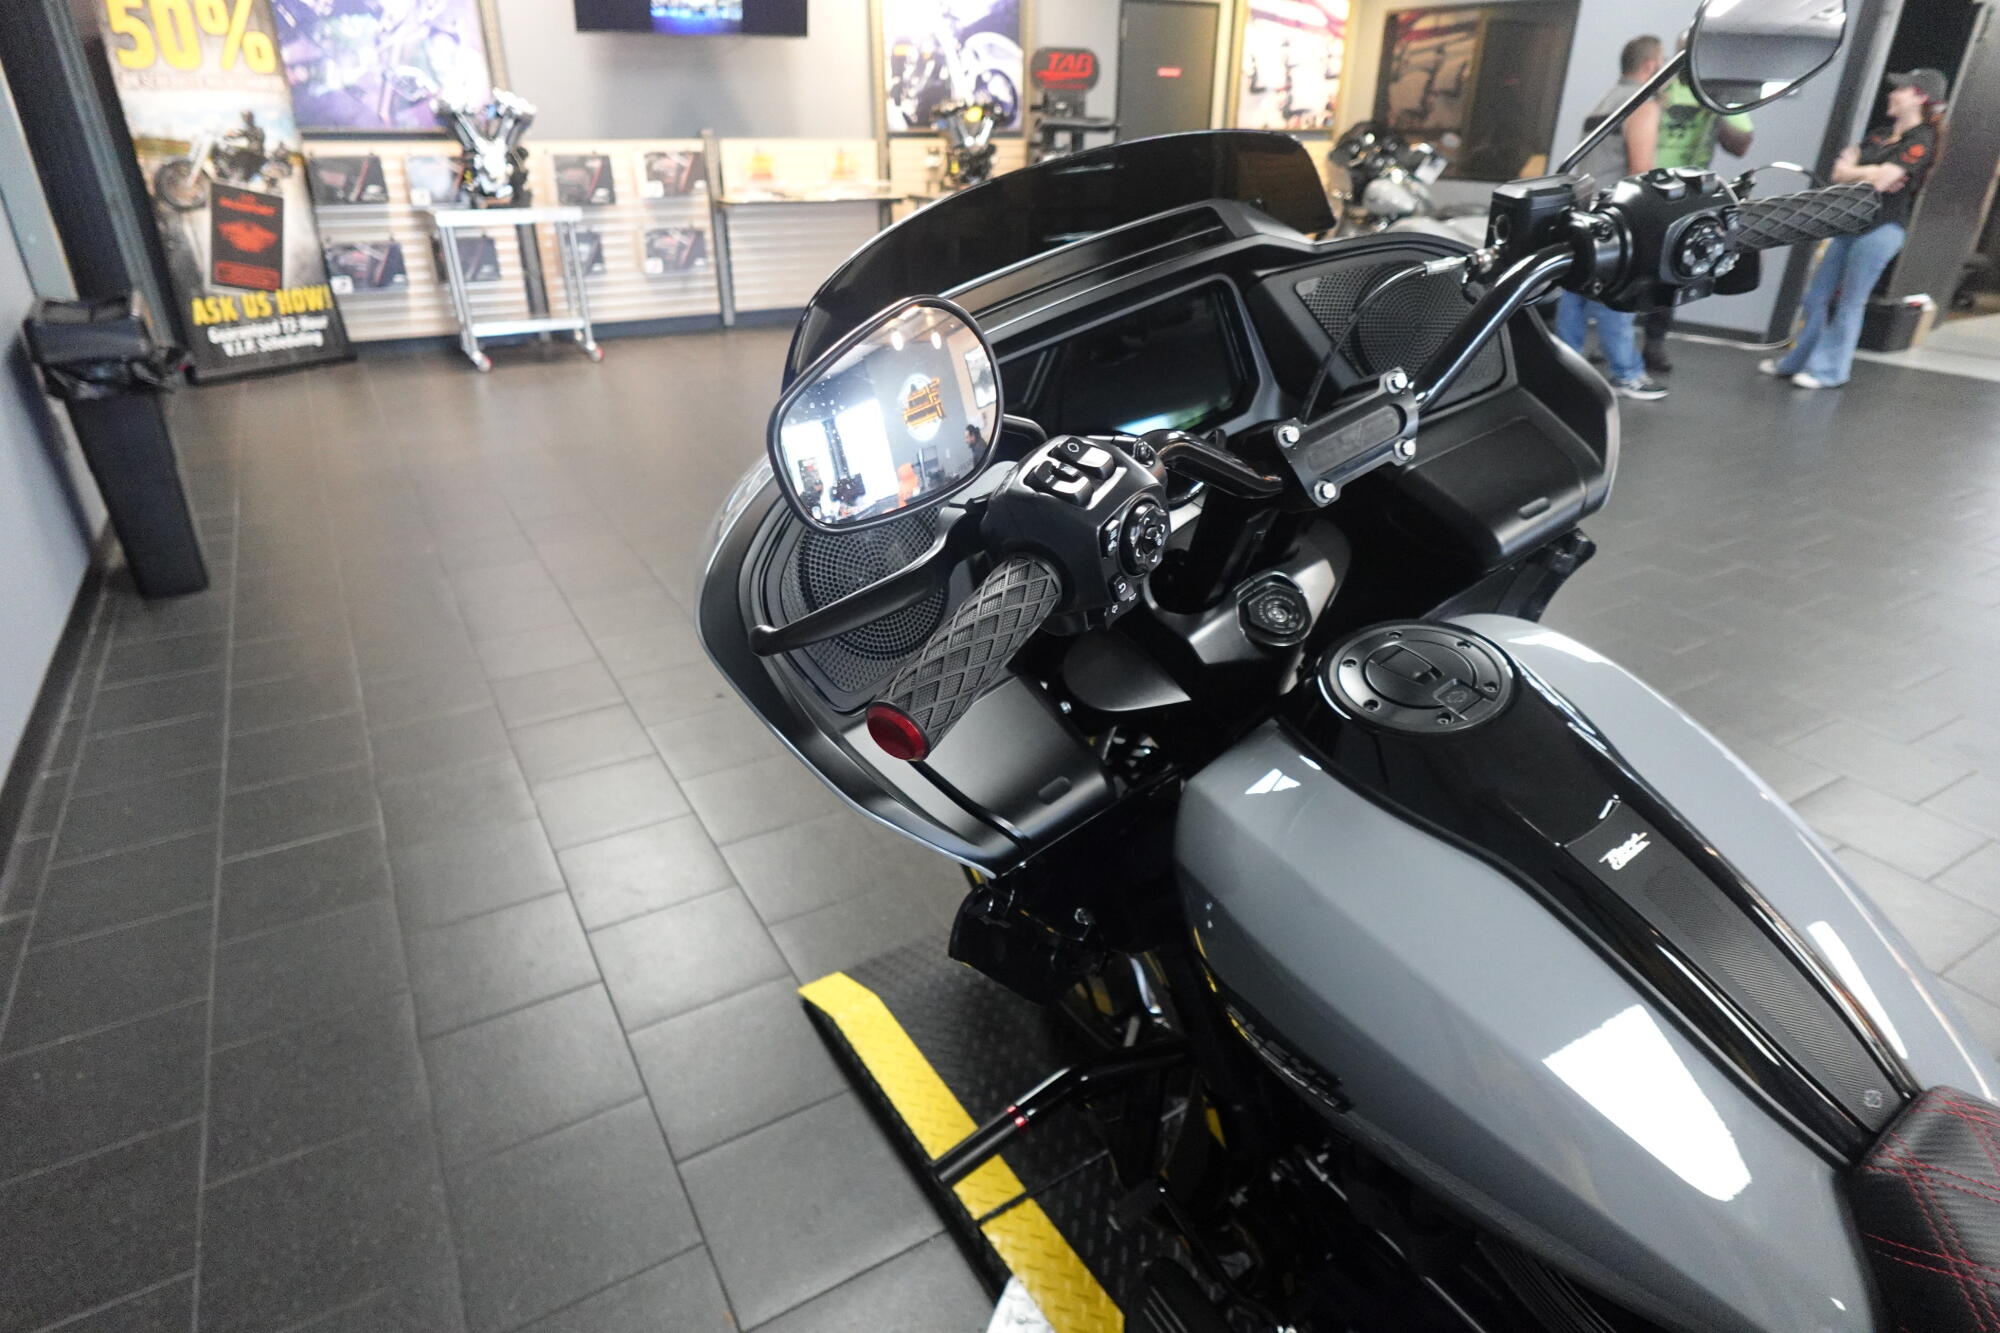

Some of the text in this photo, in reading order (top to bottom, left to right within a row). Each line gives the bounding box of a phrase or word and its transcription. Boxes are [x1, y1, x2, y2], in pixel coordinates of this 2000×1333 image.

[107, 0, 276, 73] 50%
[192, 284, 333, 326] ASK US NOW!
